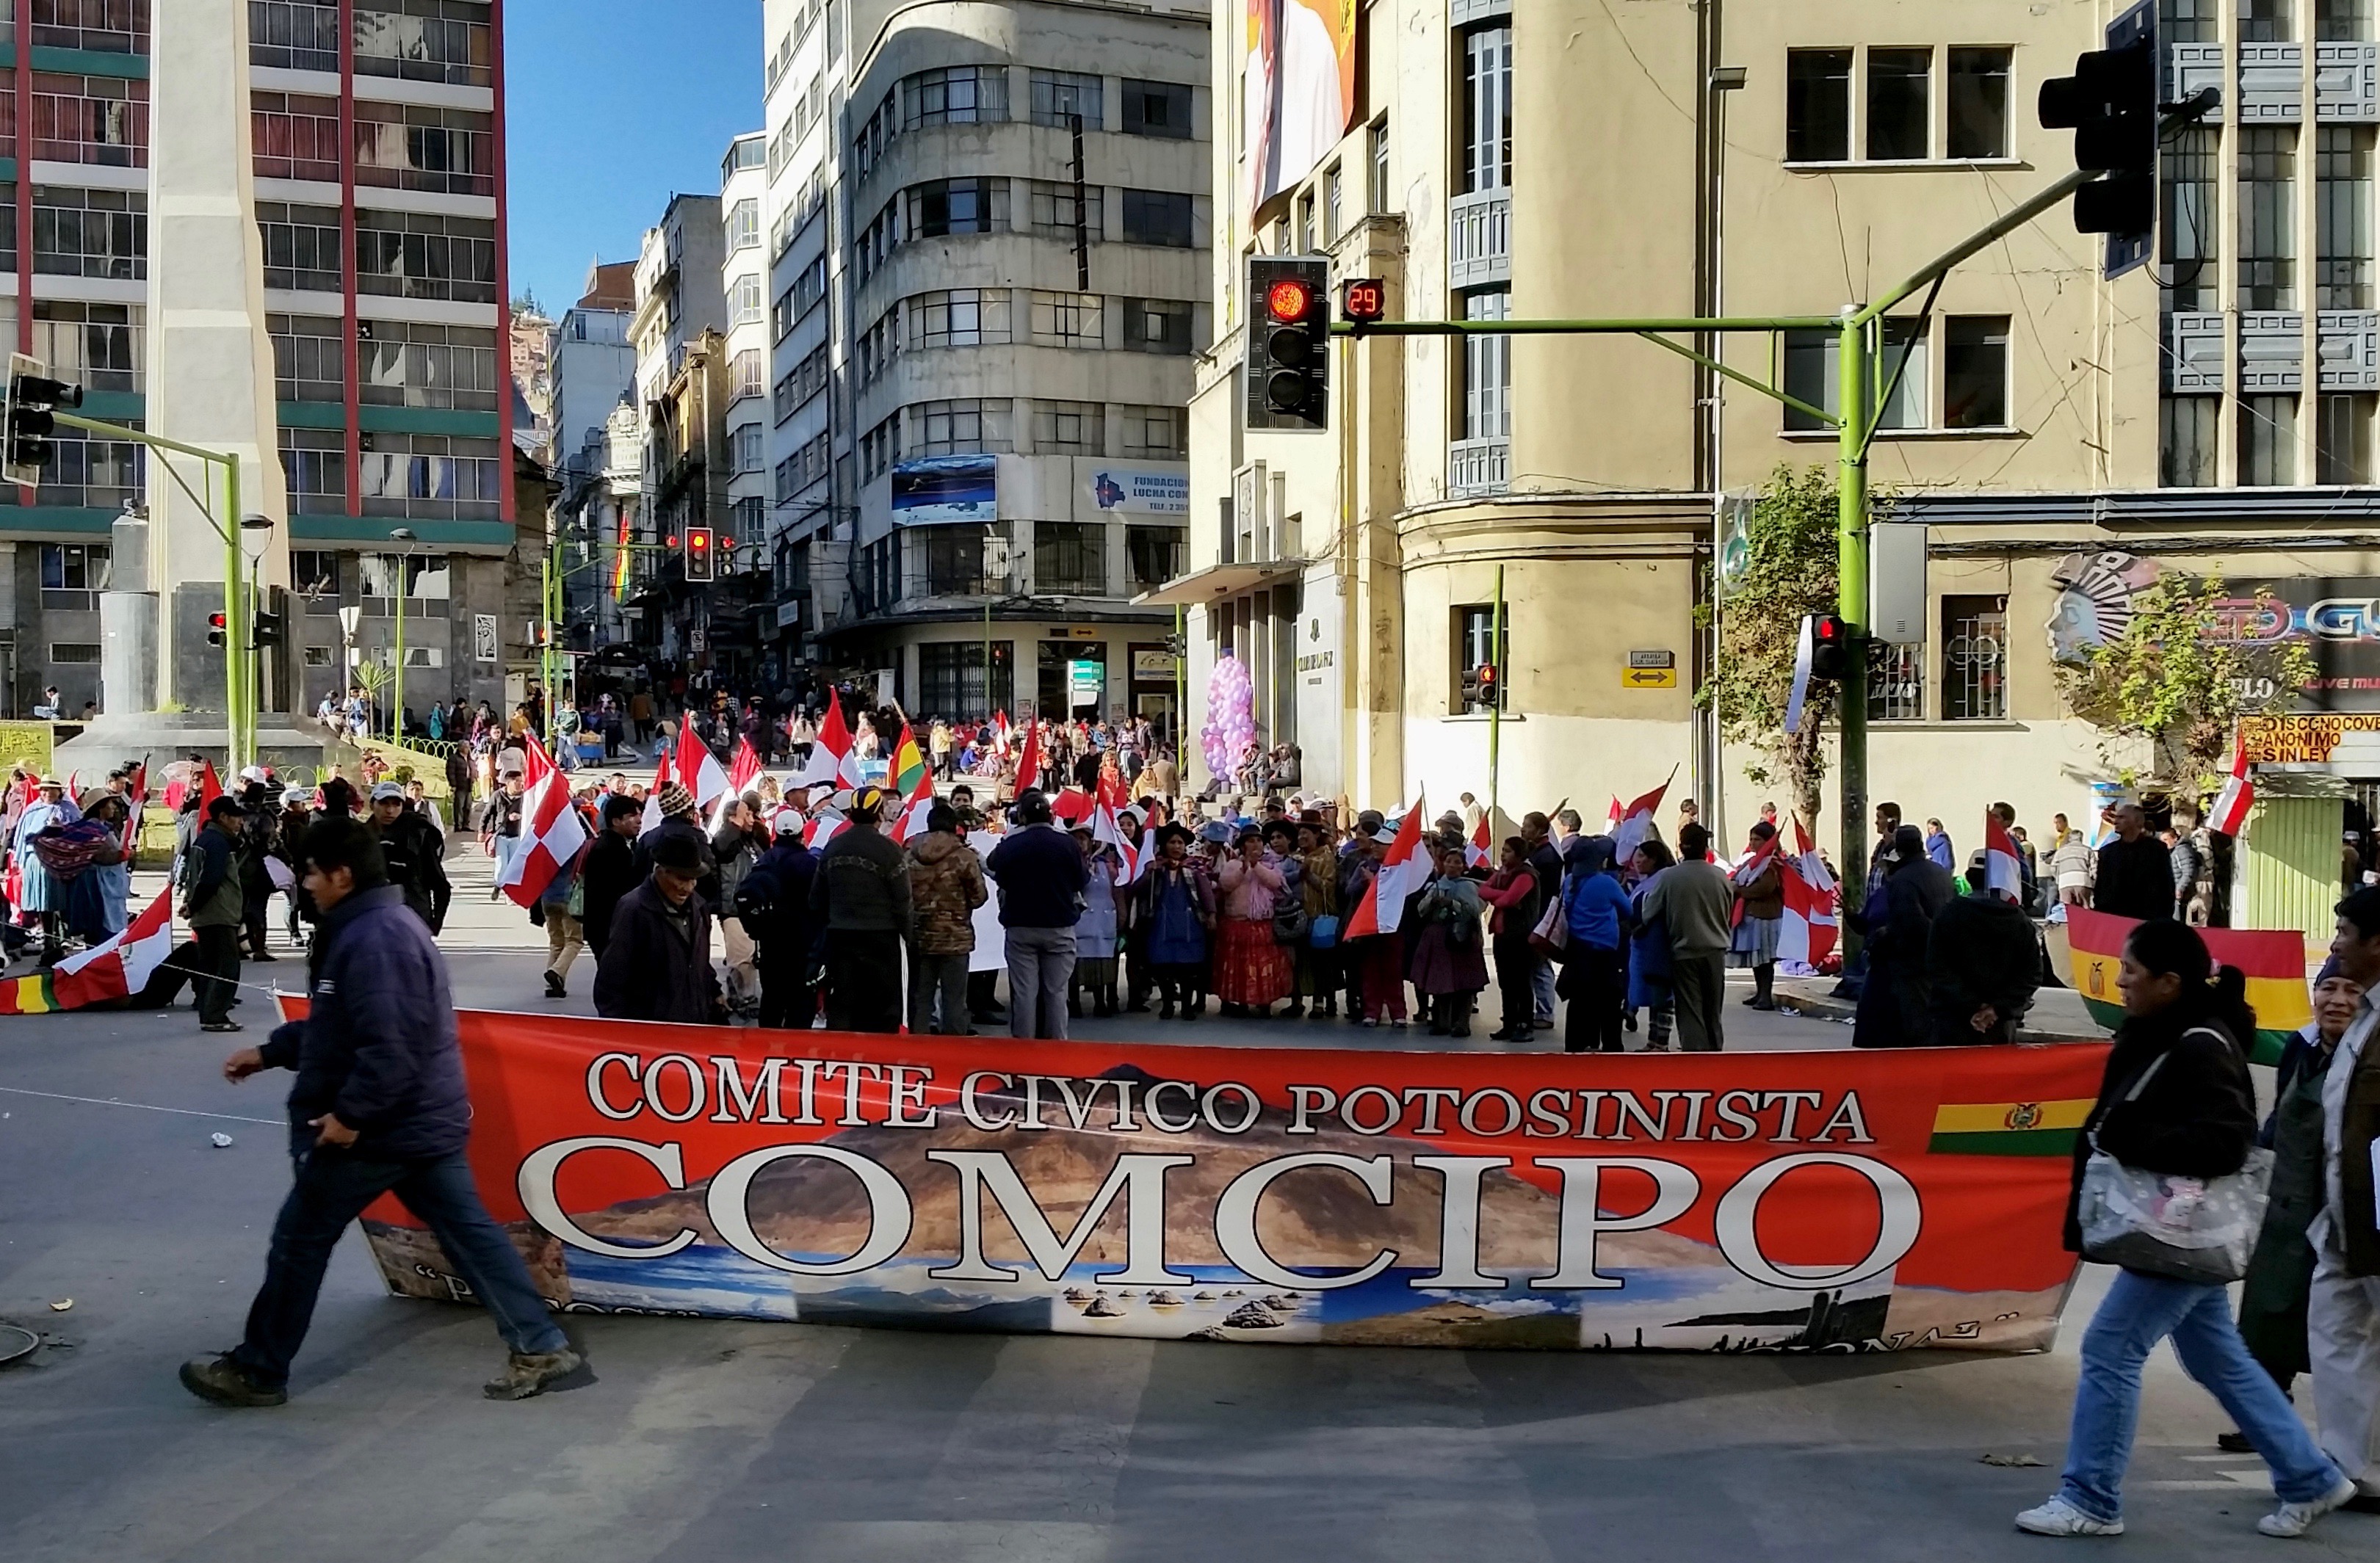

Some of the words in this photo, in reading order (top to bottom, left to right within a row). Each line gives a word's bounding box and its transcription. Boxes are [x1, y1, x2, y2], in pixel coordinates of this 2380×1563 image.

[1350, 289, 1375, 312] 29
[1133, 488, 1166, 498] LUCHA
[2305, 678, 2350, 689] LIVE
[2263, 731, 2341, 747] ANONIMO
[586, 1051, 938, 1129] COMITE
[961, 1070, 1263, 1134] CIVICO
[1287, 1084, 1876, 1145] POTOSINISTA
[516, 1136, 1923, 1291] COMCIPO
